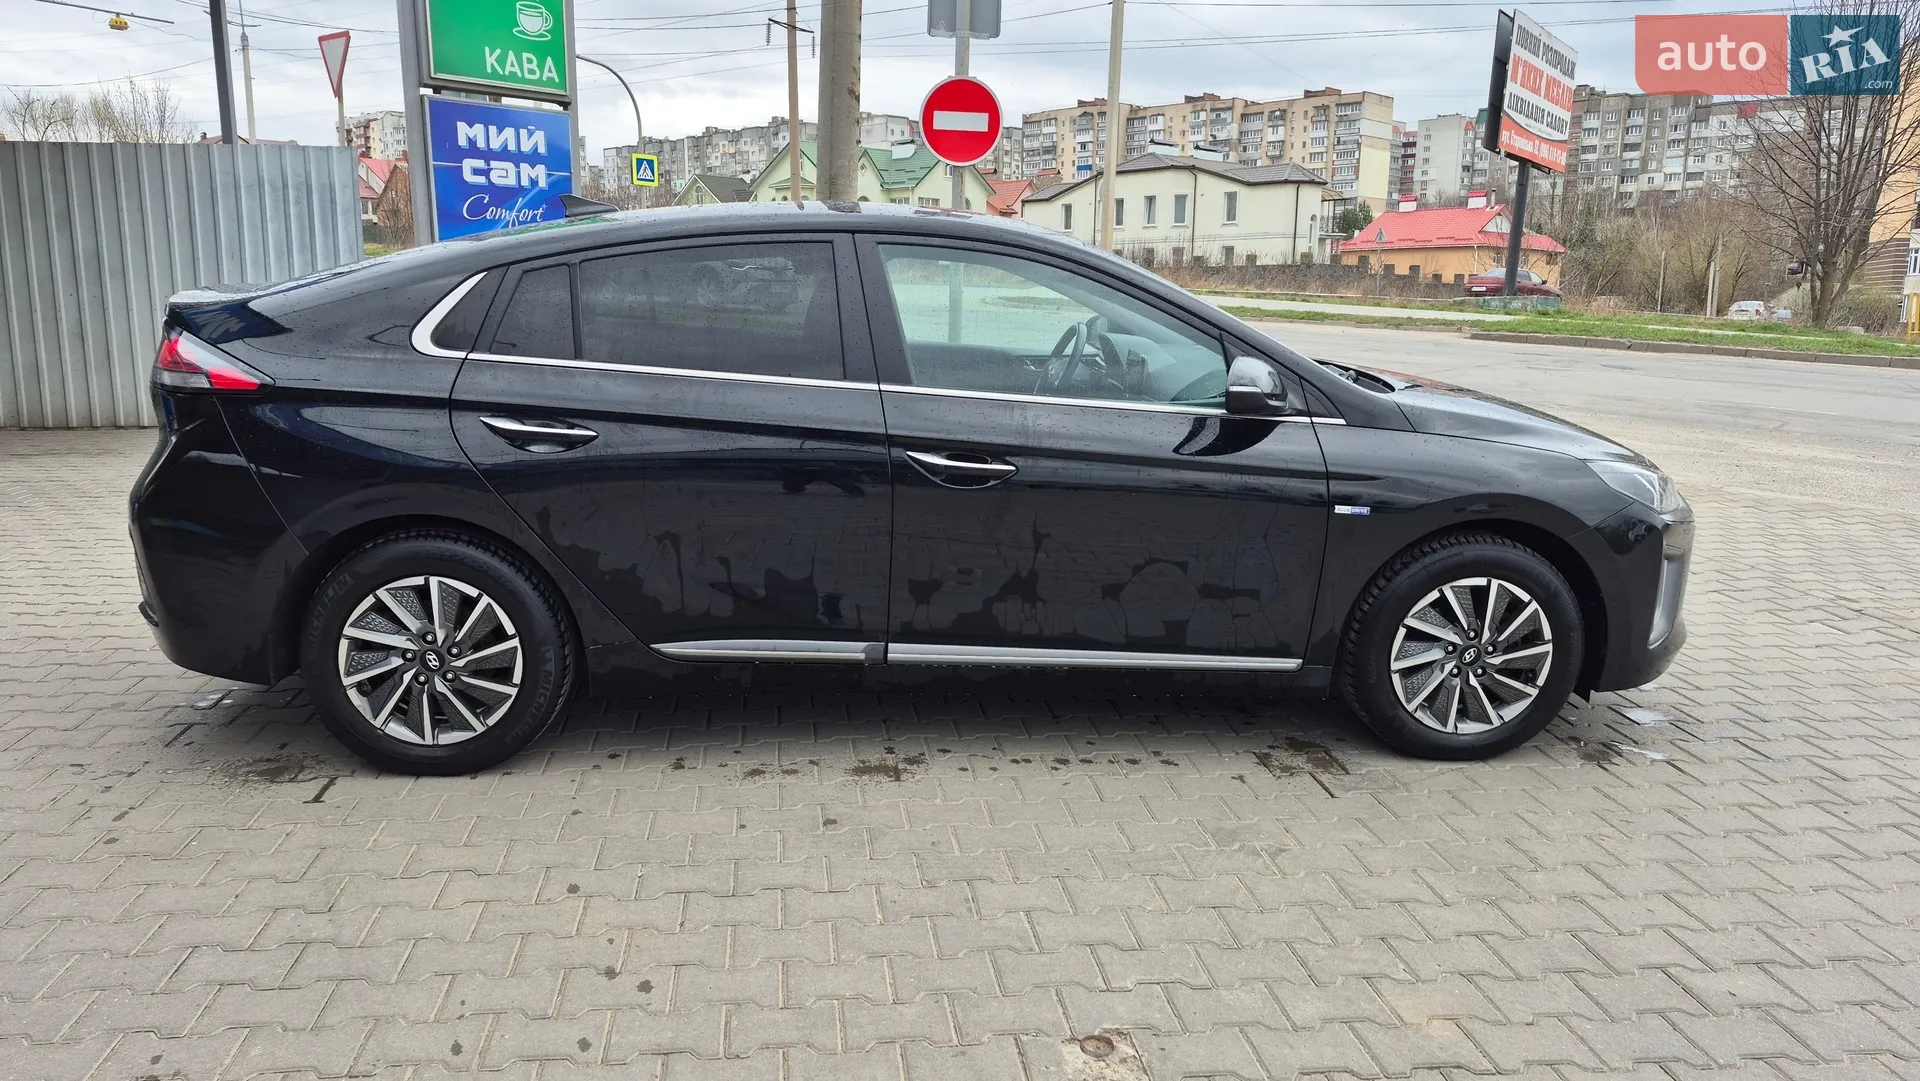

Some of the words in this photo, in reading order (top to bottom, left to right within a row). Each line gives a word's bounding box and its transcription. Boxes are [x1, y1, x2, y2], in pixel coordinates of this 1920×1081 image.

[484, 46, 559, 83] КАВА
[1515, 23, 1541, 59] ПОВНИЙ
[1541, 43, 1576, 81] РОЗПРОДАЖ
[1507, 91, 1545, 124] ЛІКВІДАЦІЯ
[1544, 73, 1573, 113] МЕБЛІВ
[463, 194, 545, 229] Comfort
